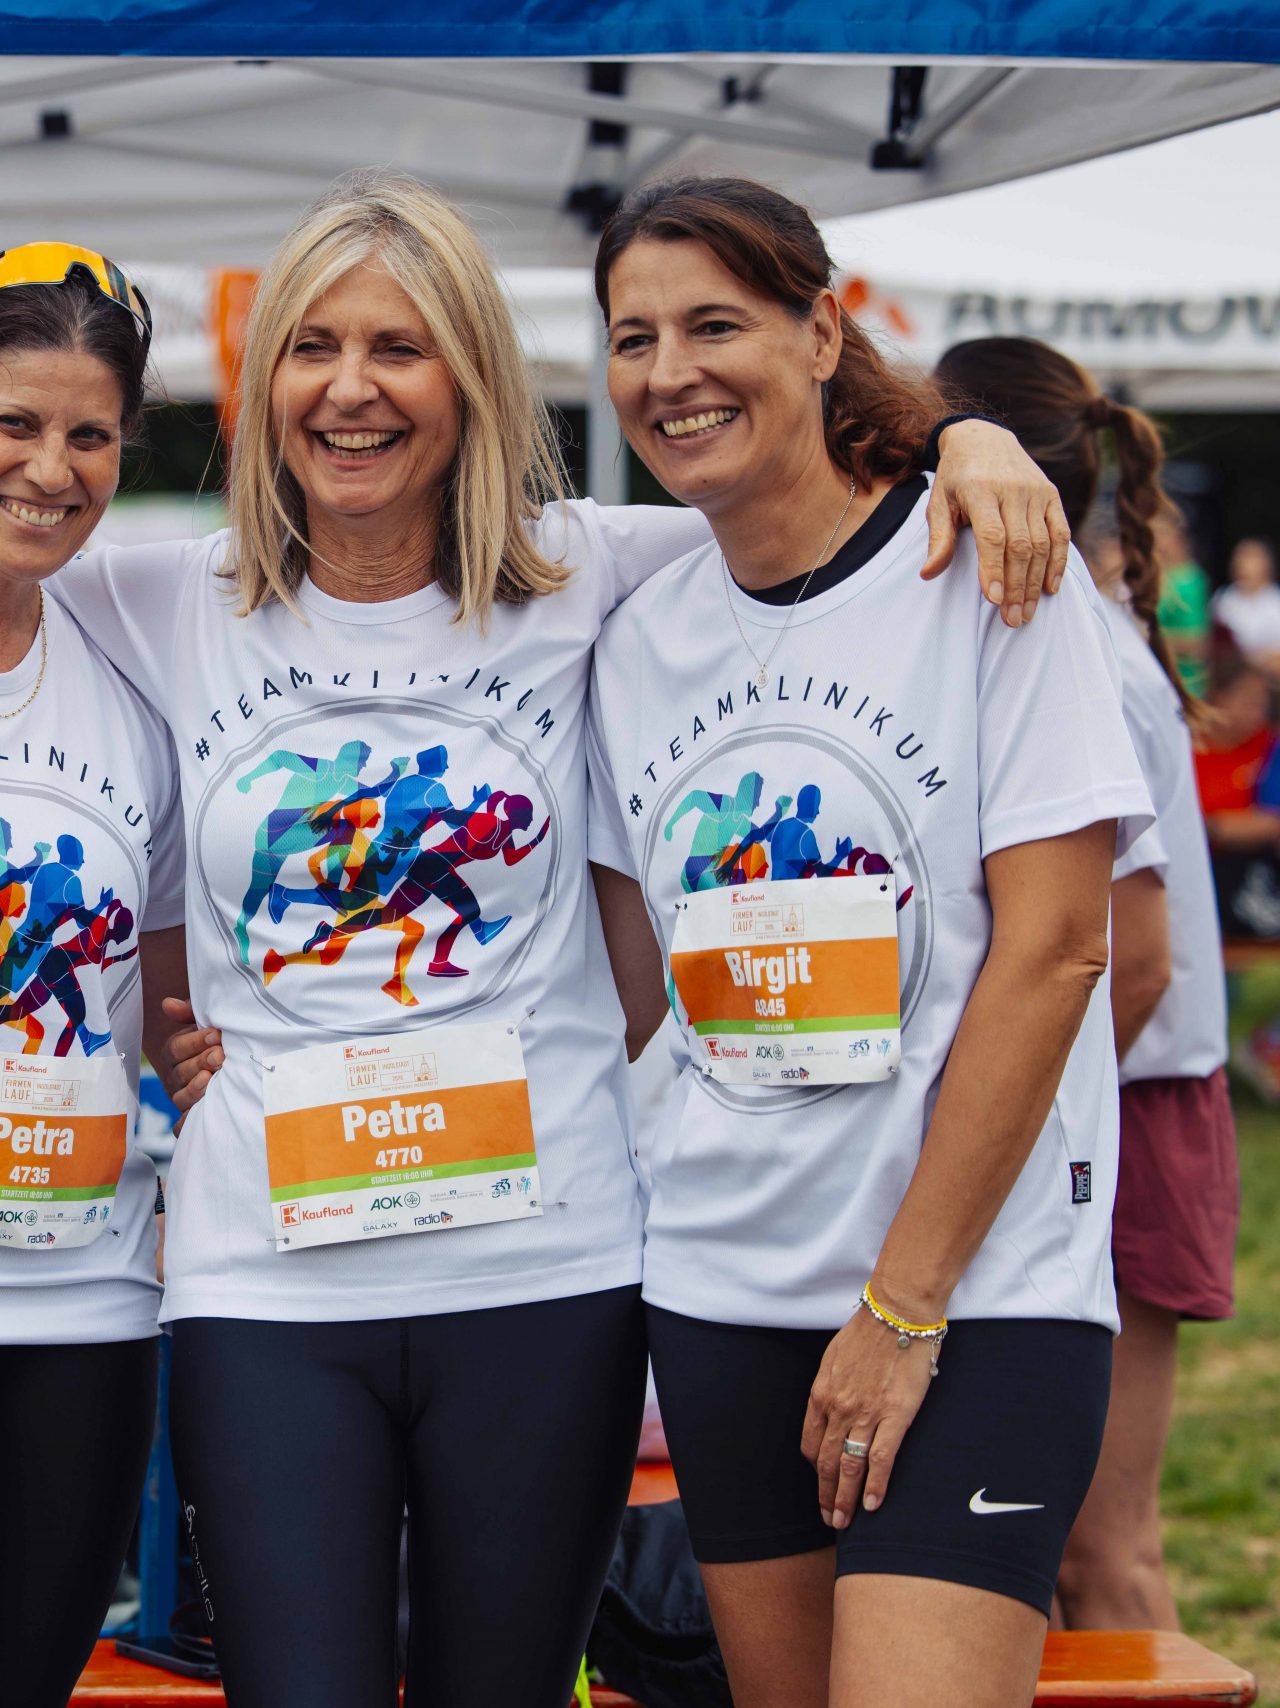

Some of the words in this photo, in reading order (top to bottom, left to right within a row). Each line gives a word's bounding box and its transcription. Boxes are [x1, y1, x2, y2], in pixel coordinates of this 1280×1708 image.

[628, 675, 948, 817] #TEAMKLINIKUM
[732, 920, 753, 933] LAUF
[724, 946, 812, 994] Birgit
[754, 997, 786, 1017] 4845
[357, 1046, 390, 1057] Kaufland
[755, 1046, 773, 1059] AOK
[18, 1064, 48, 1074] Kaufland
[348, 1063, 377, 1074] FIRMEN
[5, 1079, 32, 1089] FIRMEN
[349, 1073, 377, 1087] LAUF
[4, 1088, 31, 1101] LAUF
[341, 1100, 446, 1142] Petra
[375, 1145, 423, 1168] 4770
[9, 1165, 51, 1184] 4735
[370, 1195, 403, 1211] AOK
[302, 1204, 354, 1221] Kaufland
[362, 1222, 398, 1232] GALAXY
